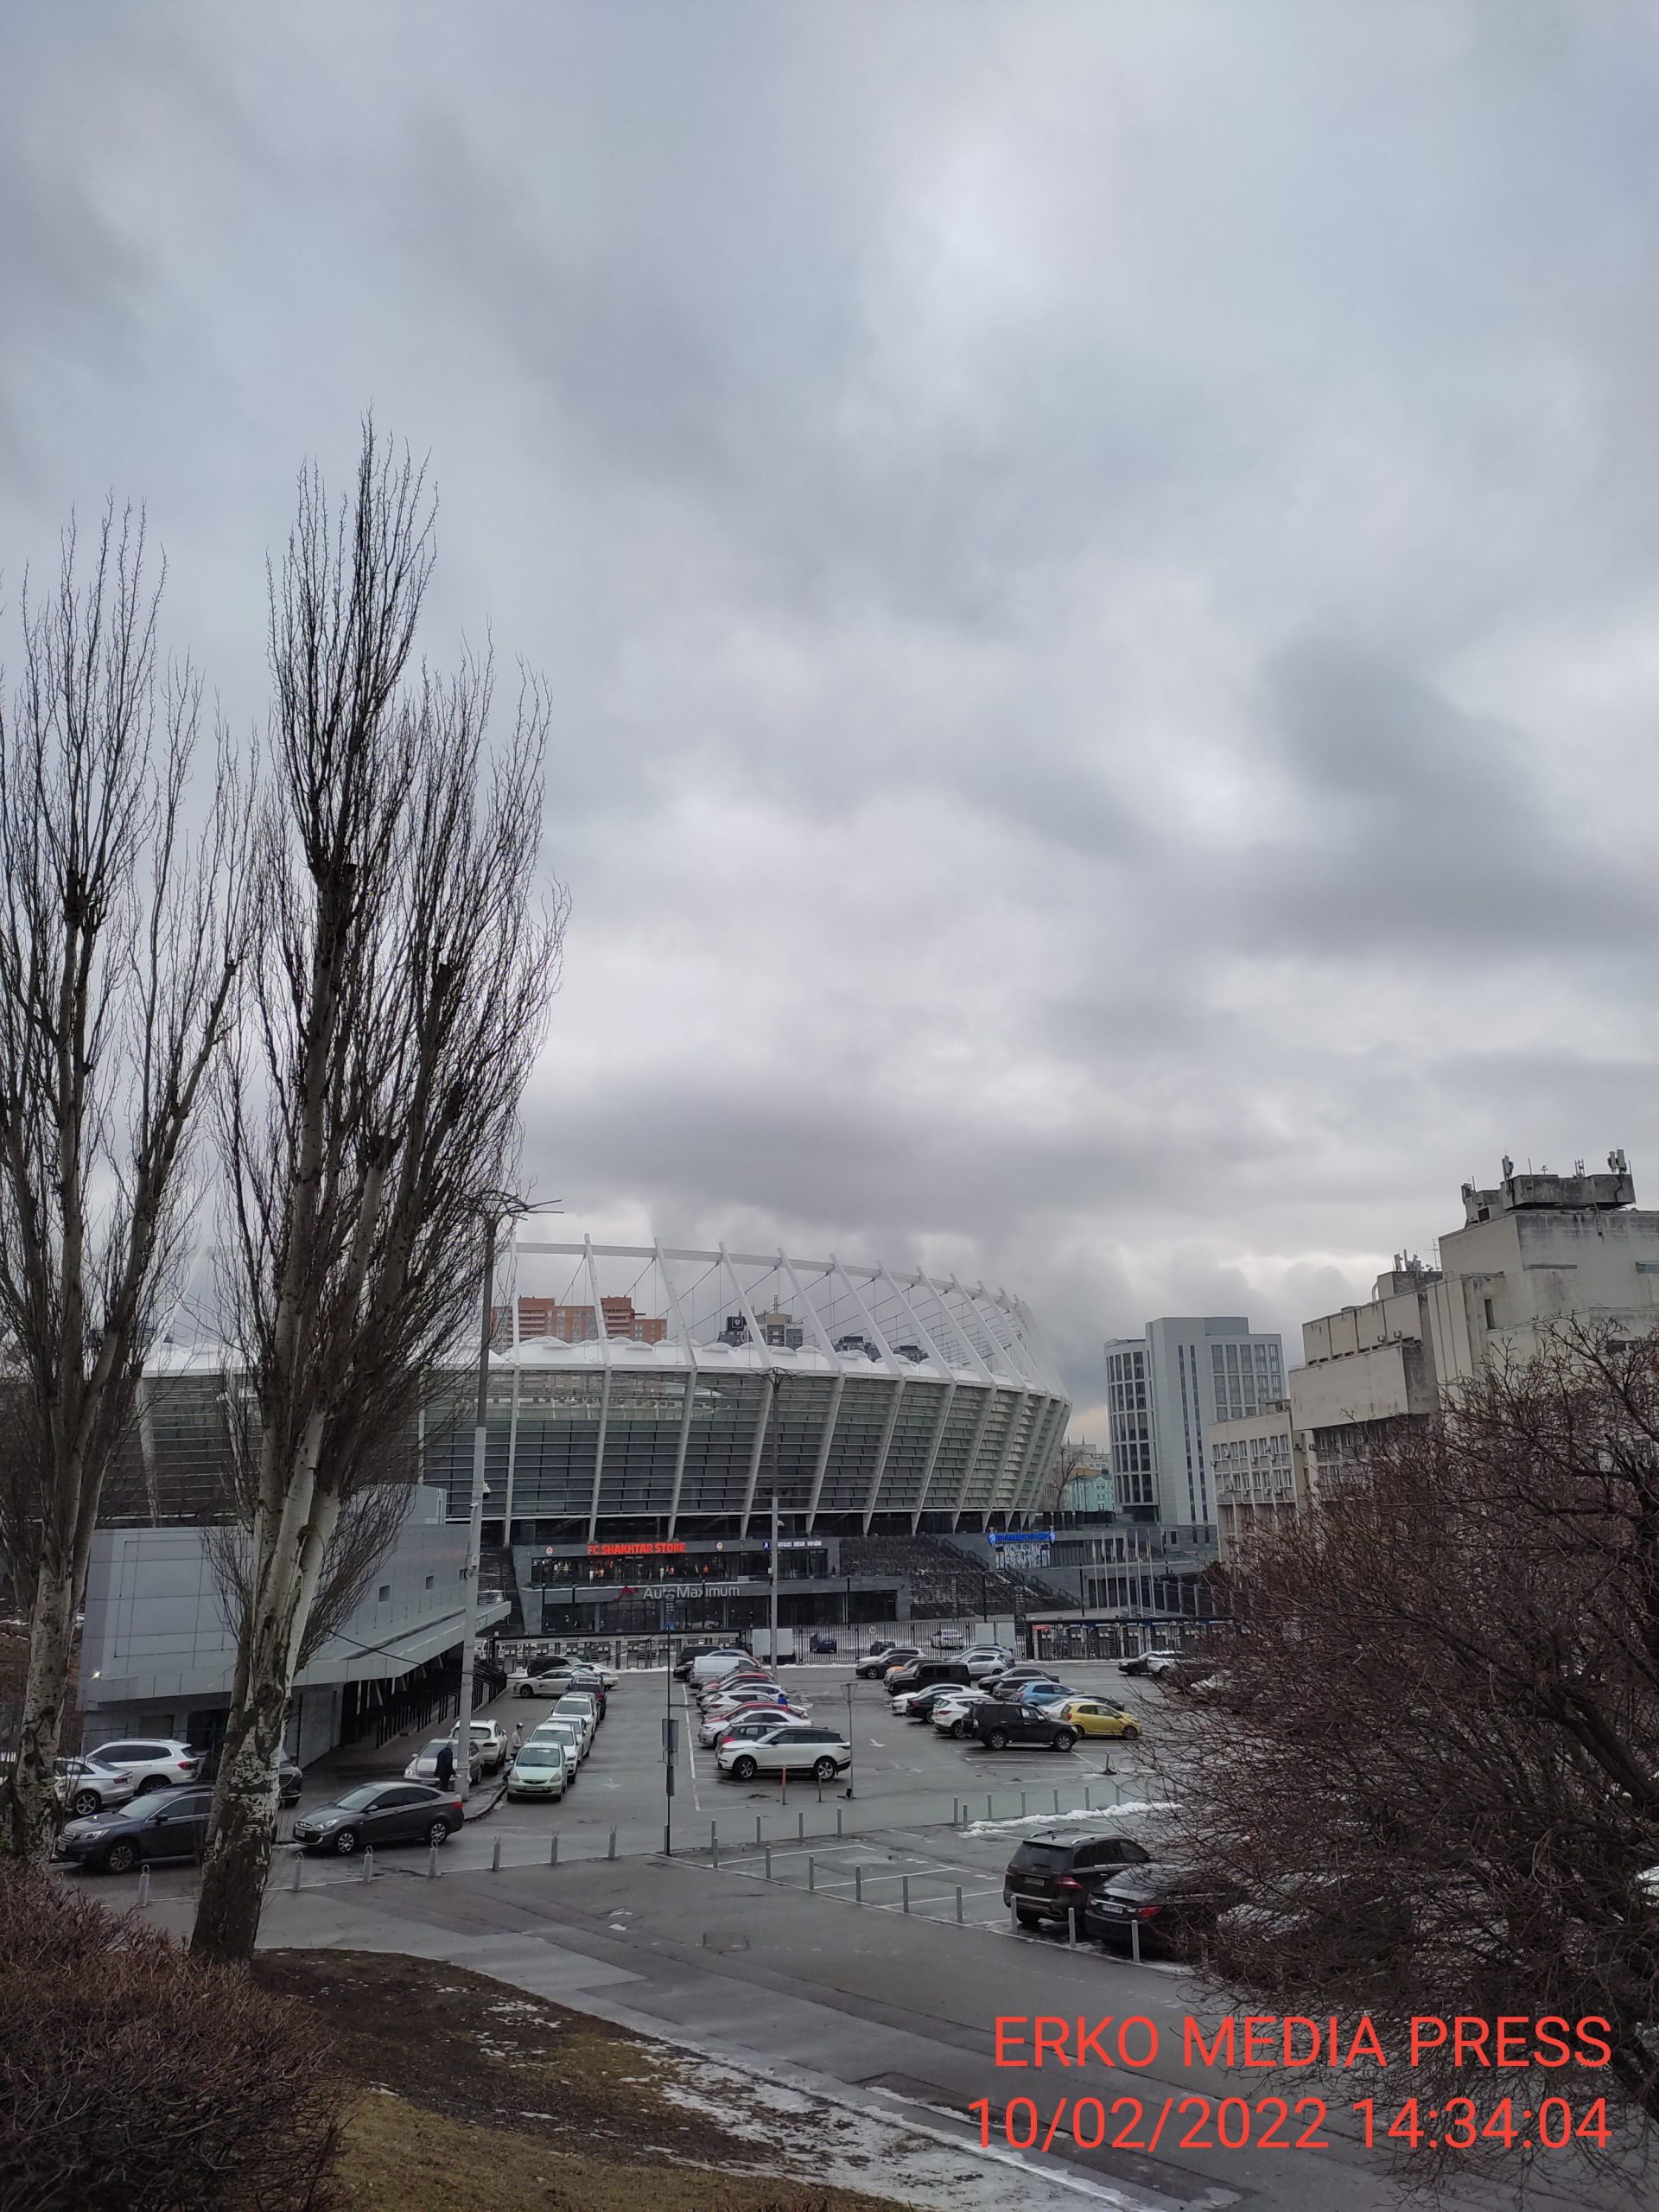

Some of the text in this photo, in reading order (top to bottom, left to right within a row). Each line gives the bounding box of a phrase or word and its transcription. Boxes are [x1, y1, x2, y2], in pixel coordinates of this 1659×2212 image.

[587, 1541, 686, 1554] FC SHAKHTAR STORE
